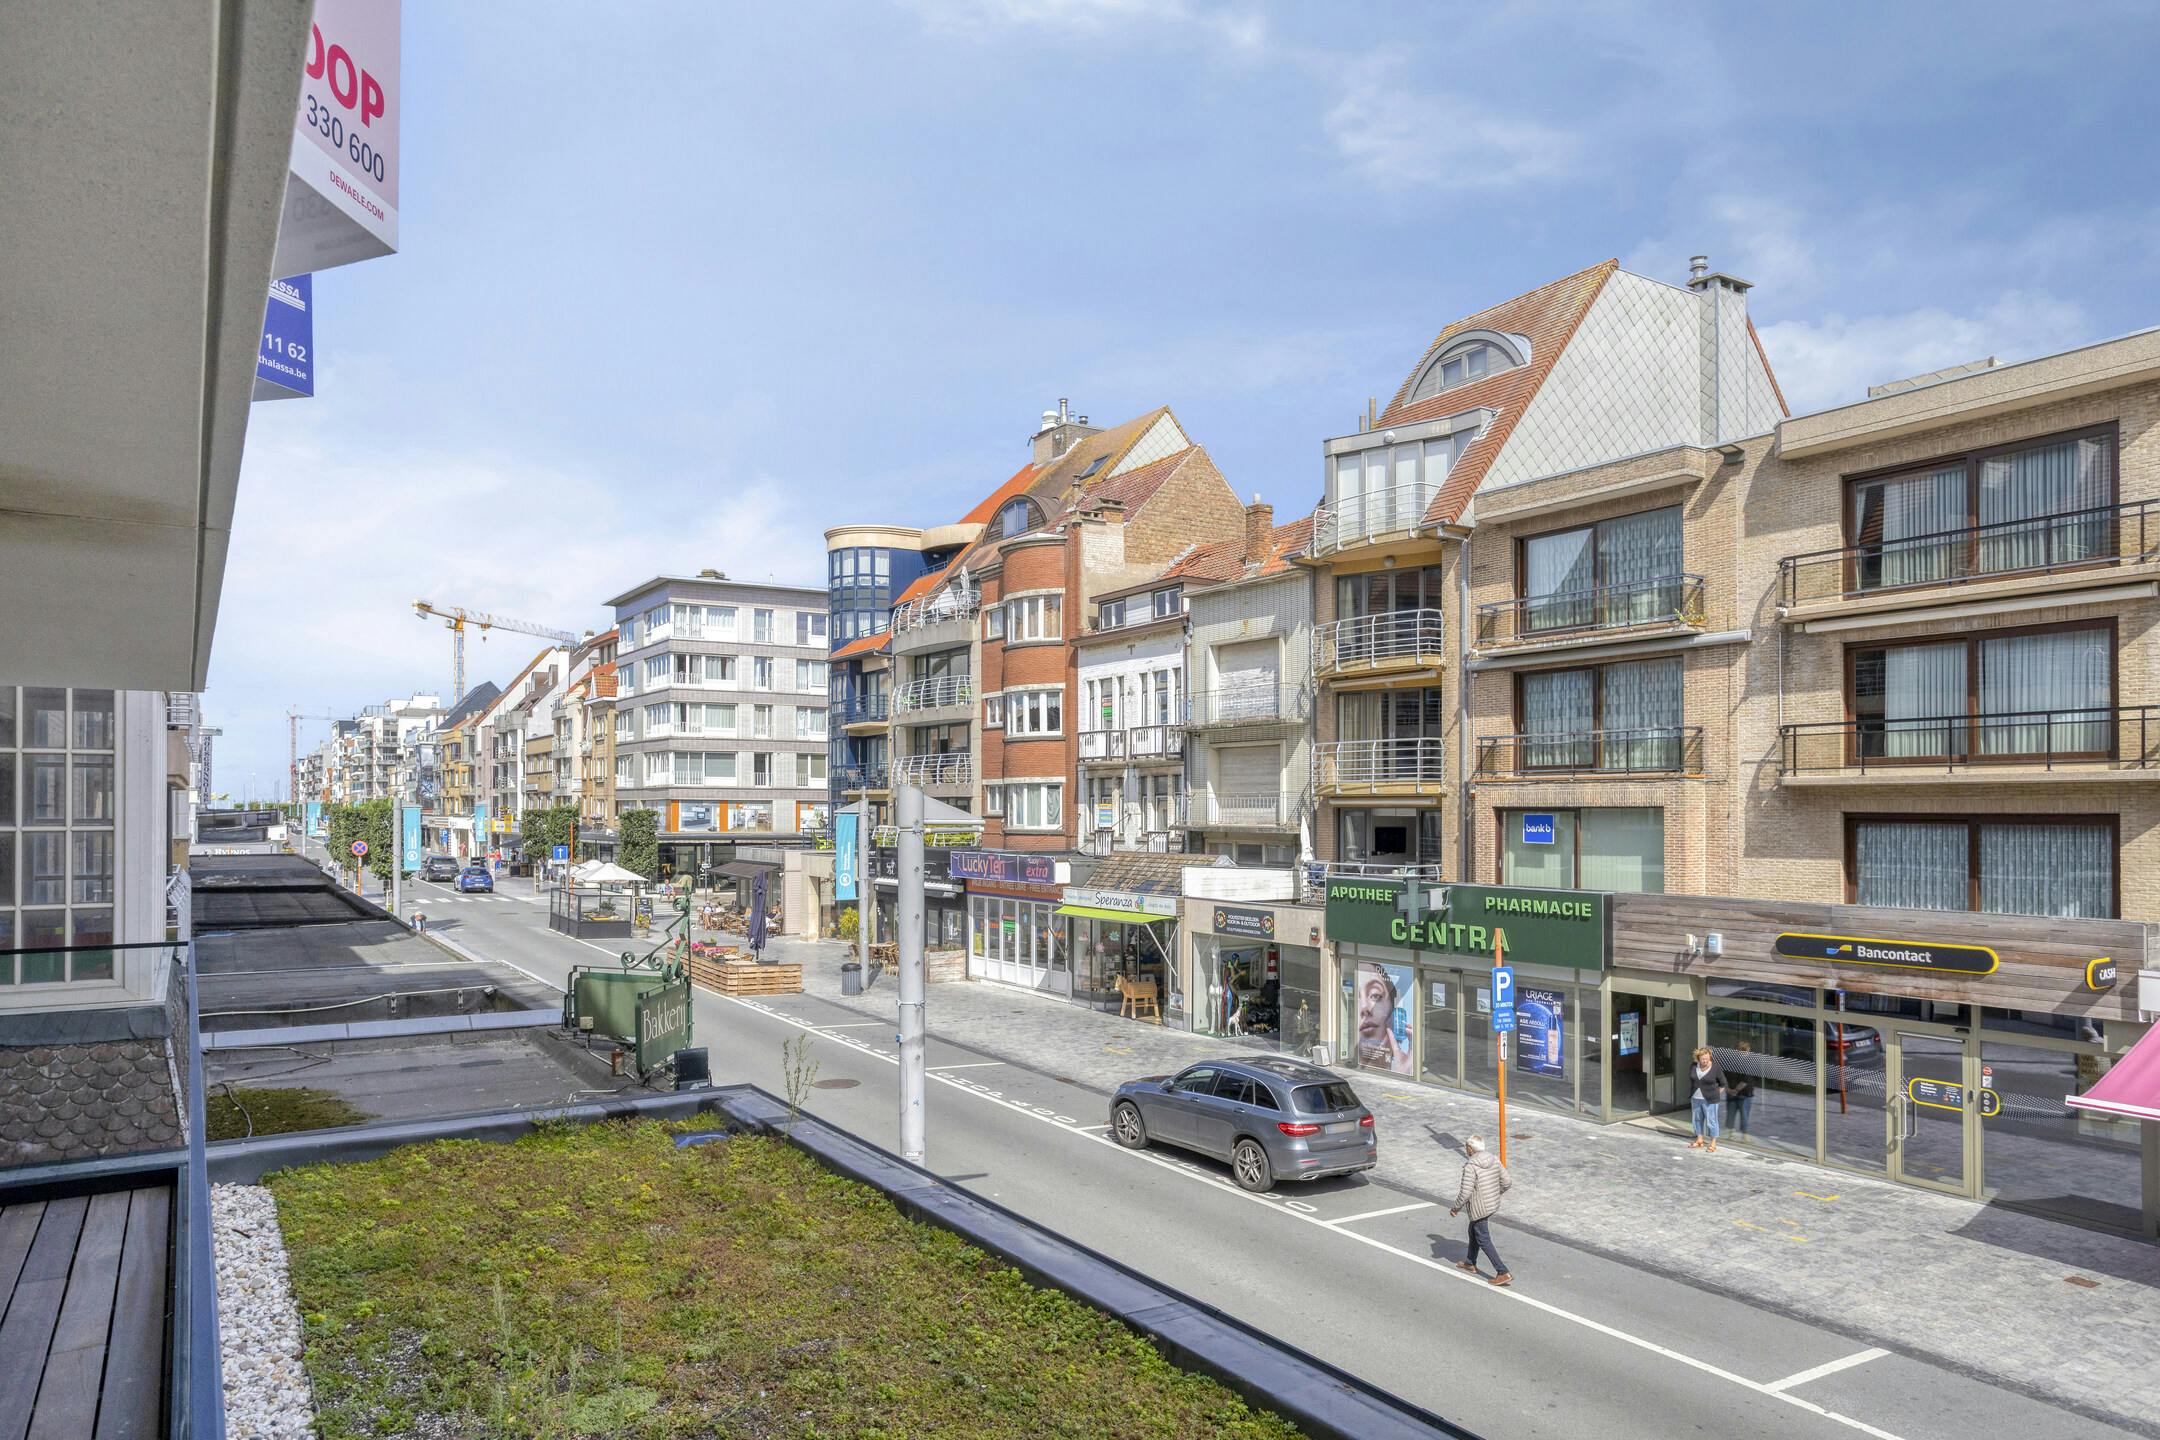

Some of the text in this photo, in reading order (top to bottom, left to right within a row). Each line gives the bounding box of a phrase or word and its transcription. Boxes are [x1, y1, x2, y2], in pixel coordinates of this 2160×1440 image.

[306, 94, 384, 182] 330 600
[329, 170, 384, 222] DEWAELE.COM
[265, 333, 307, 363] 11 62
[1025, 865, 1049, 878] extra
[1095, 891, 1133, 908] Speranza
[1331, 886, 1593, 917] APOTHEE PHARMACIE
[1391, 918, 1511, 952] CENTRA
[1857, 945, 1932, 963] Bancontact
[1496, 971, 1511, 1001] P
[2099, 967, 2116, 980] CASH
[1525, 989, 1553, 1001] URIAGE
[643, 993, 686, 1043] Bakkerij
[937, 1071, 1003, 1099] SHOP
[1032, 1107, 1077, 1123] GO
